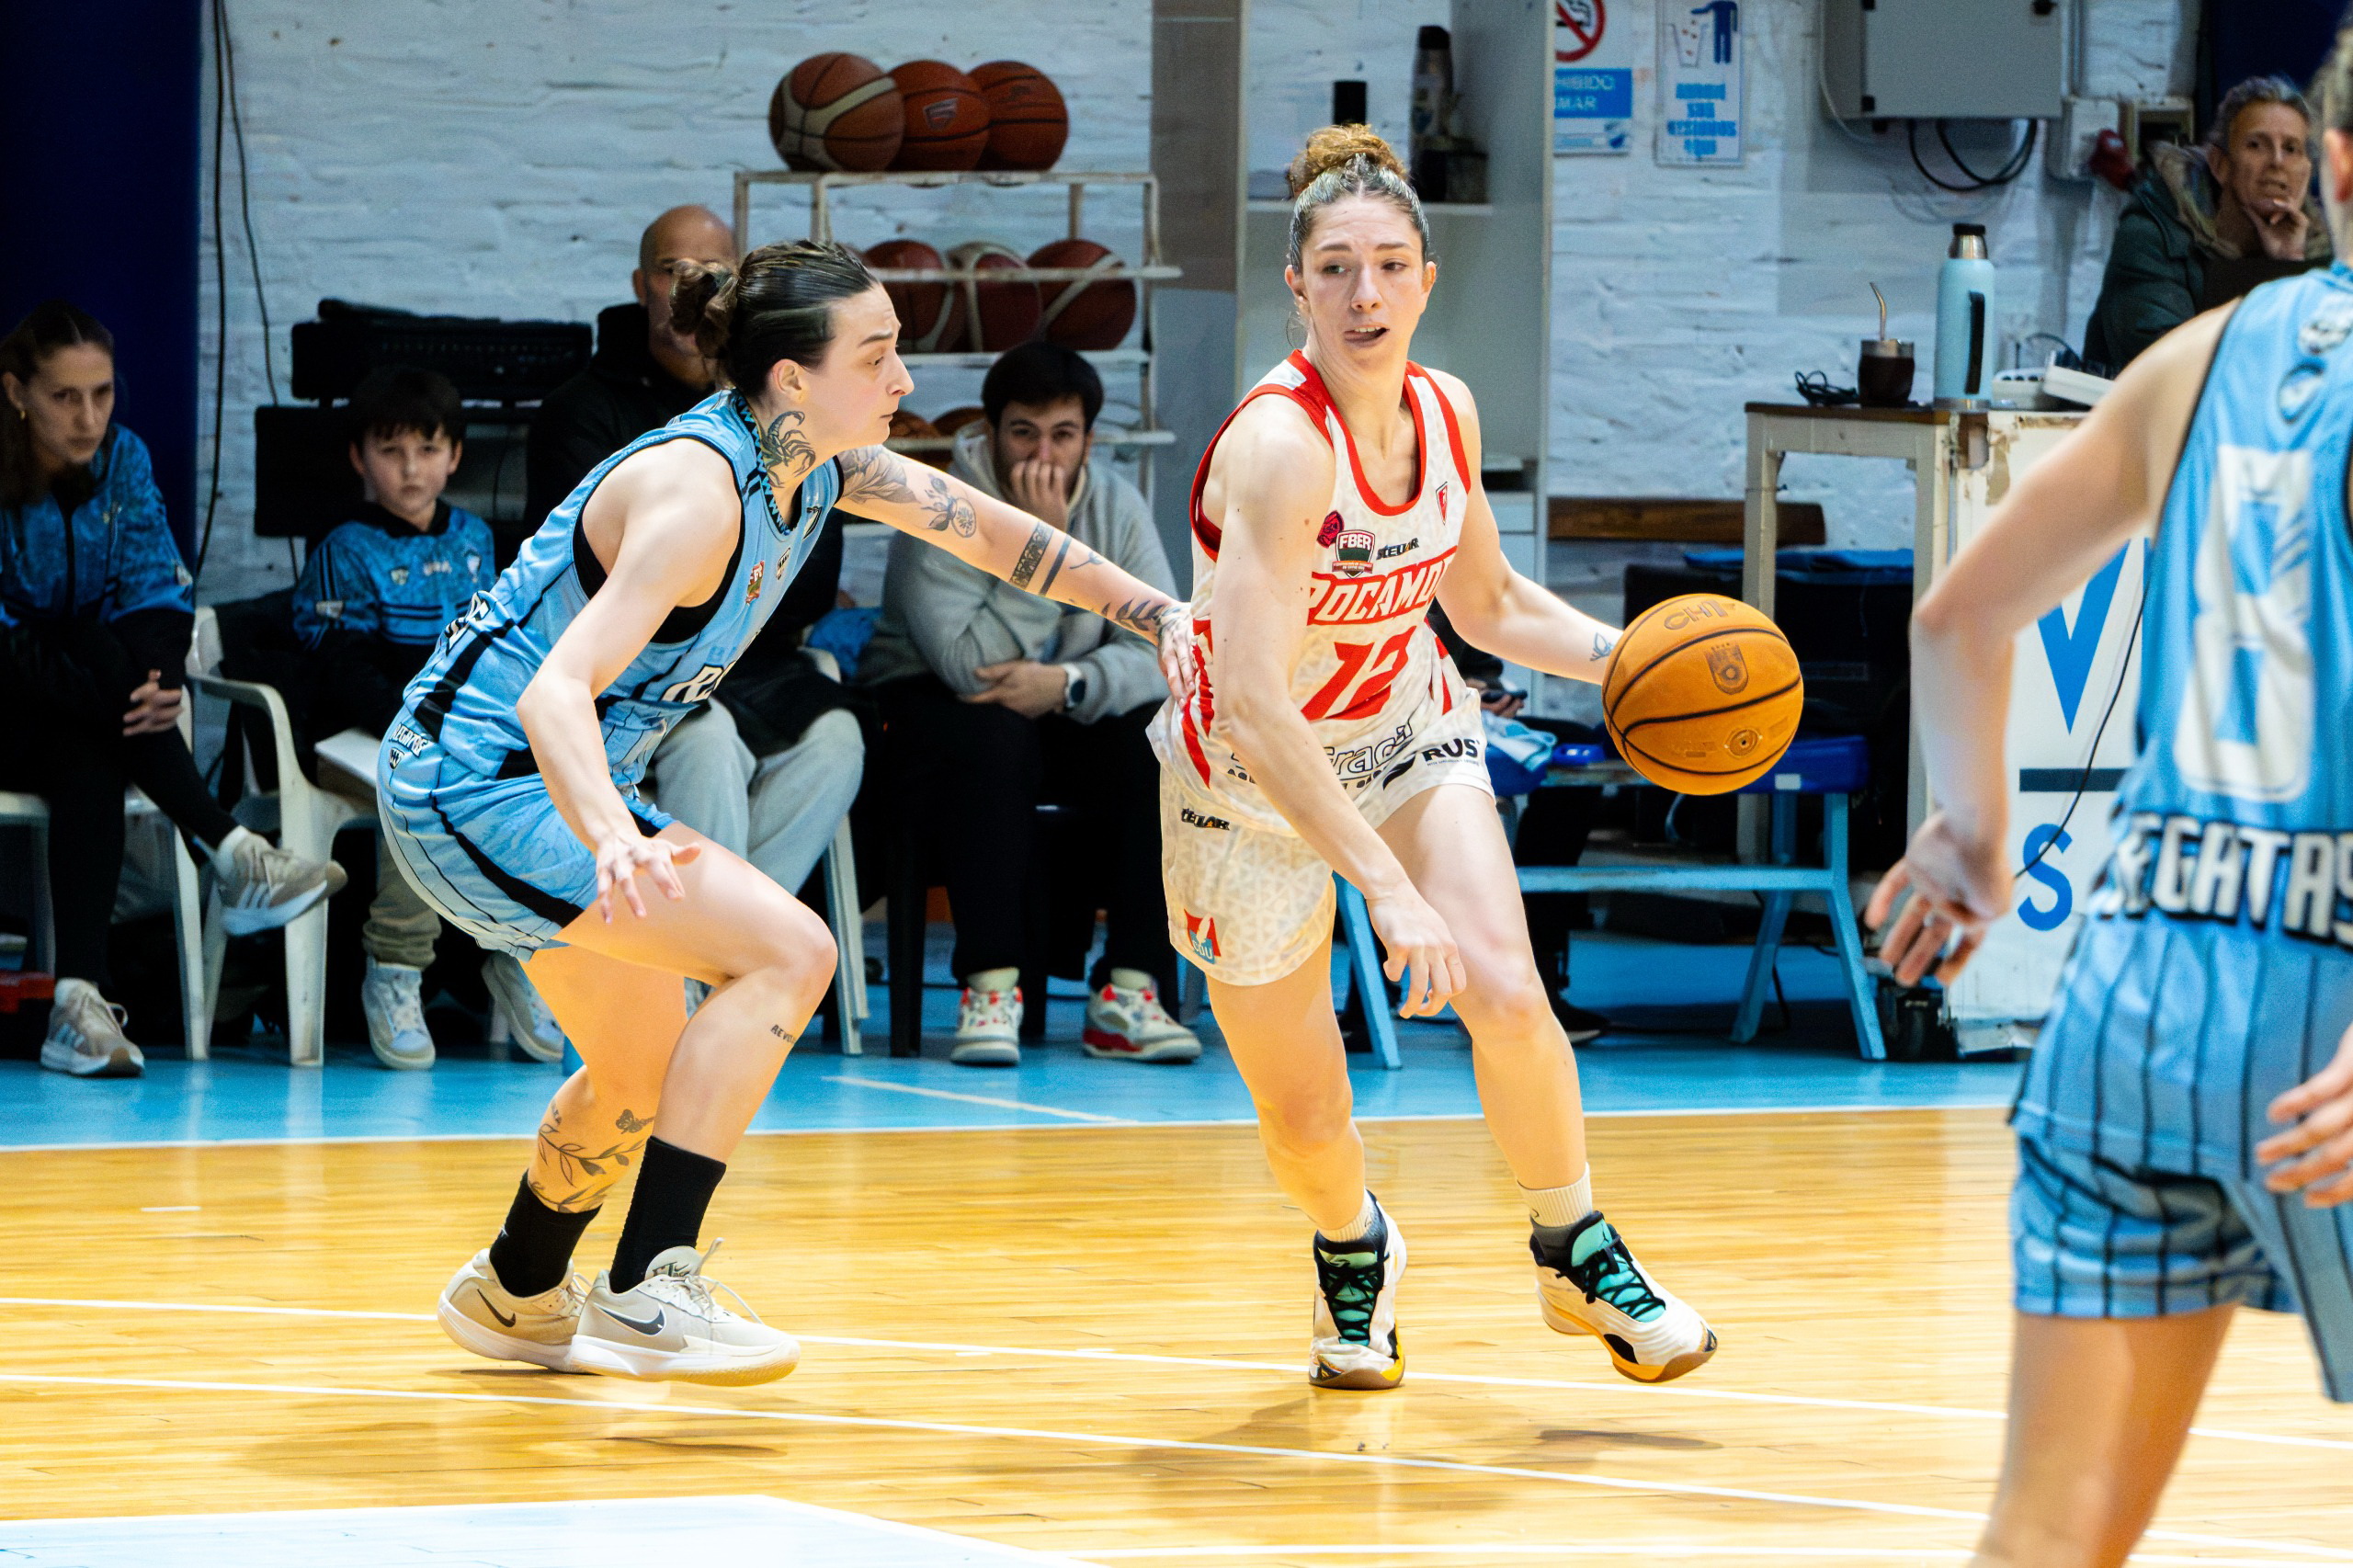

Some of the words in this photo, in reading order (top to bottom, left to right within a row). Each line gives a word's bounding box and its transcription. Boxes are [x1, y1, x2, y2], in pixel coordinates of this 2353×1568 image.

[1337, 533, 1372, 551] FBER
[1300, 625, 1417, 722] 12
[2018, 824, 2074, 931] S
